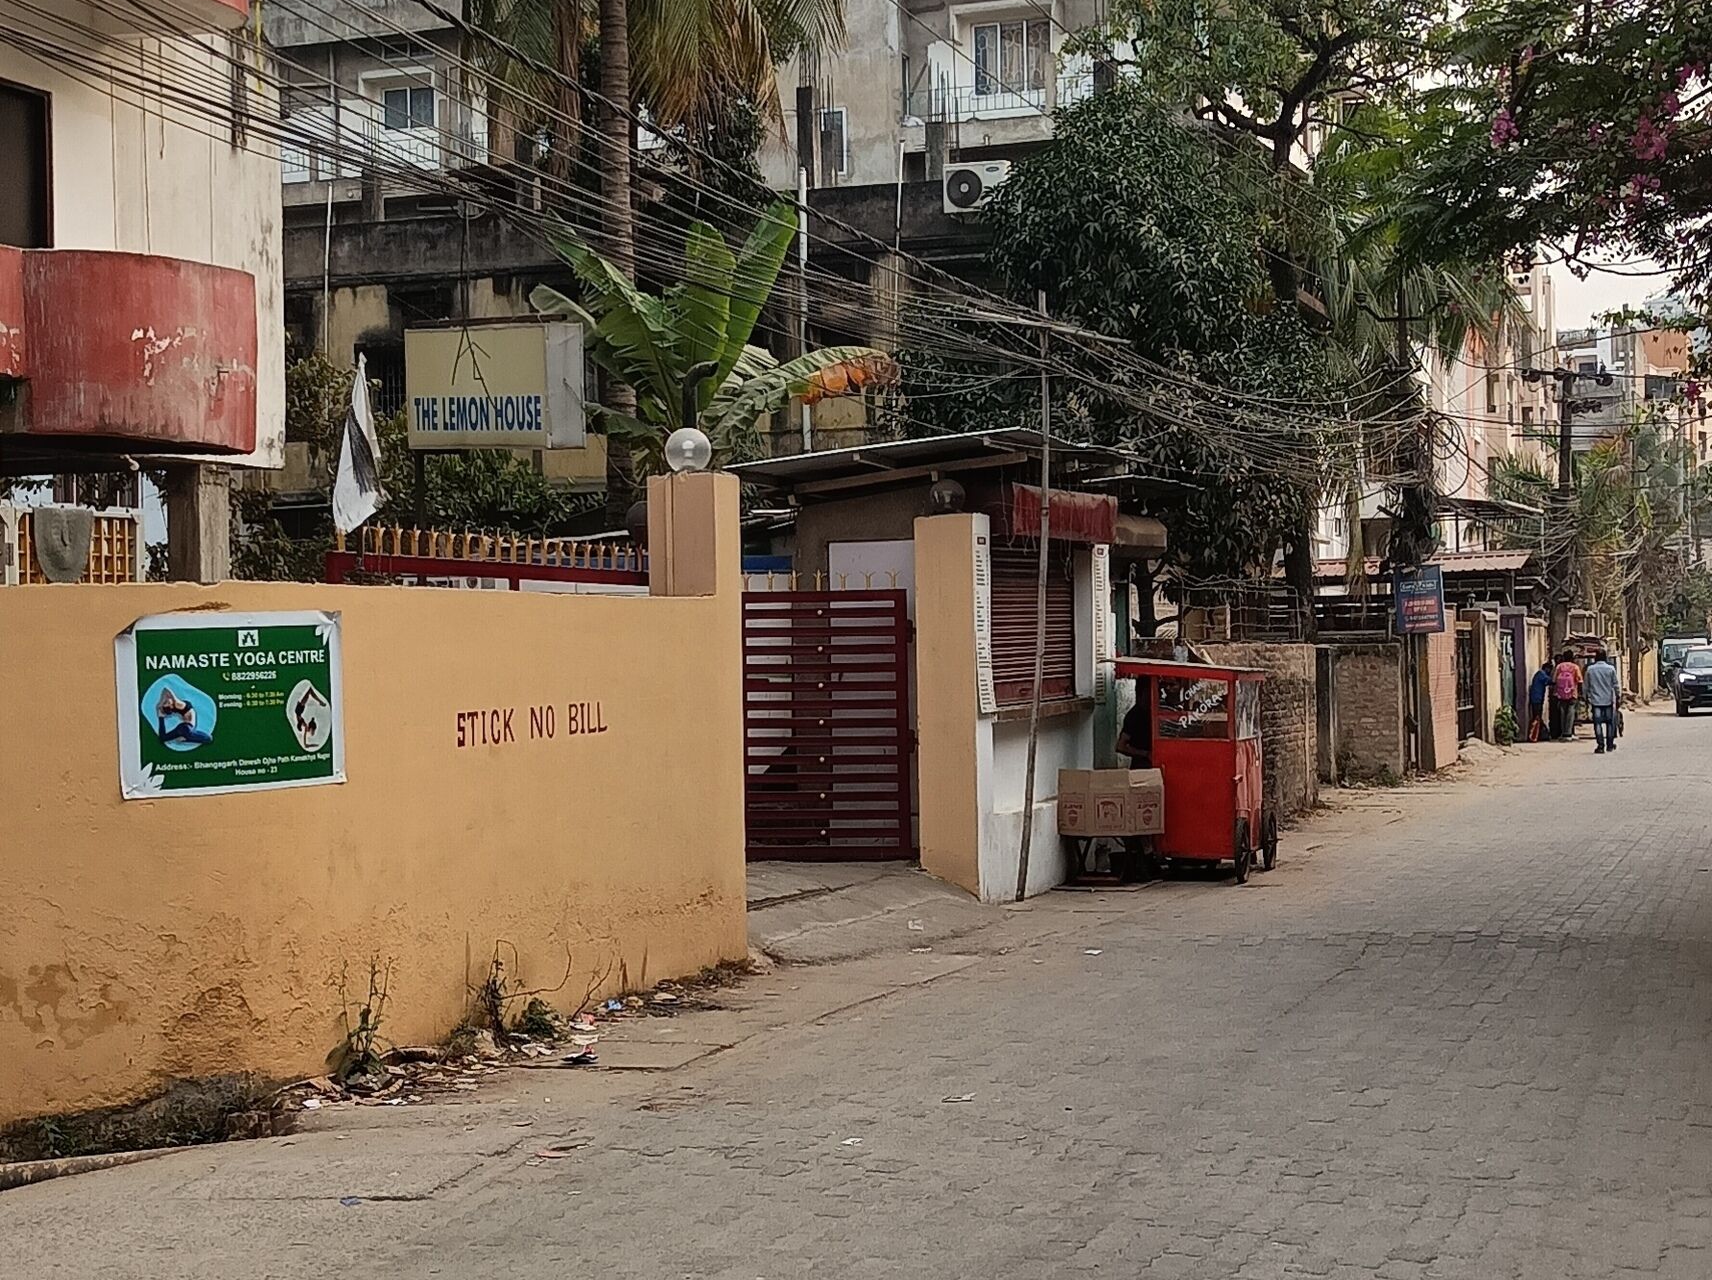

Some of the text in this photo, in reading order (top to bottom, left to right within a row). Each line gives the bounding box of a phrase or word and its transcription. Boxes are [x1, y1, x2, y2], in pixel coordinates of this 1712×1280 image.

[414, 395, 542, 431] THE LEMON HOUSE
[145, 649, 325, 670] NAMASTE YOGA CENTRE
[457, 701, 608, 748] STICK NO BILL
